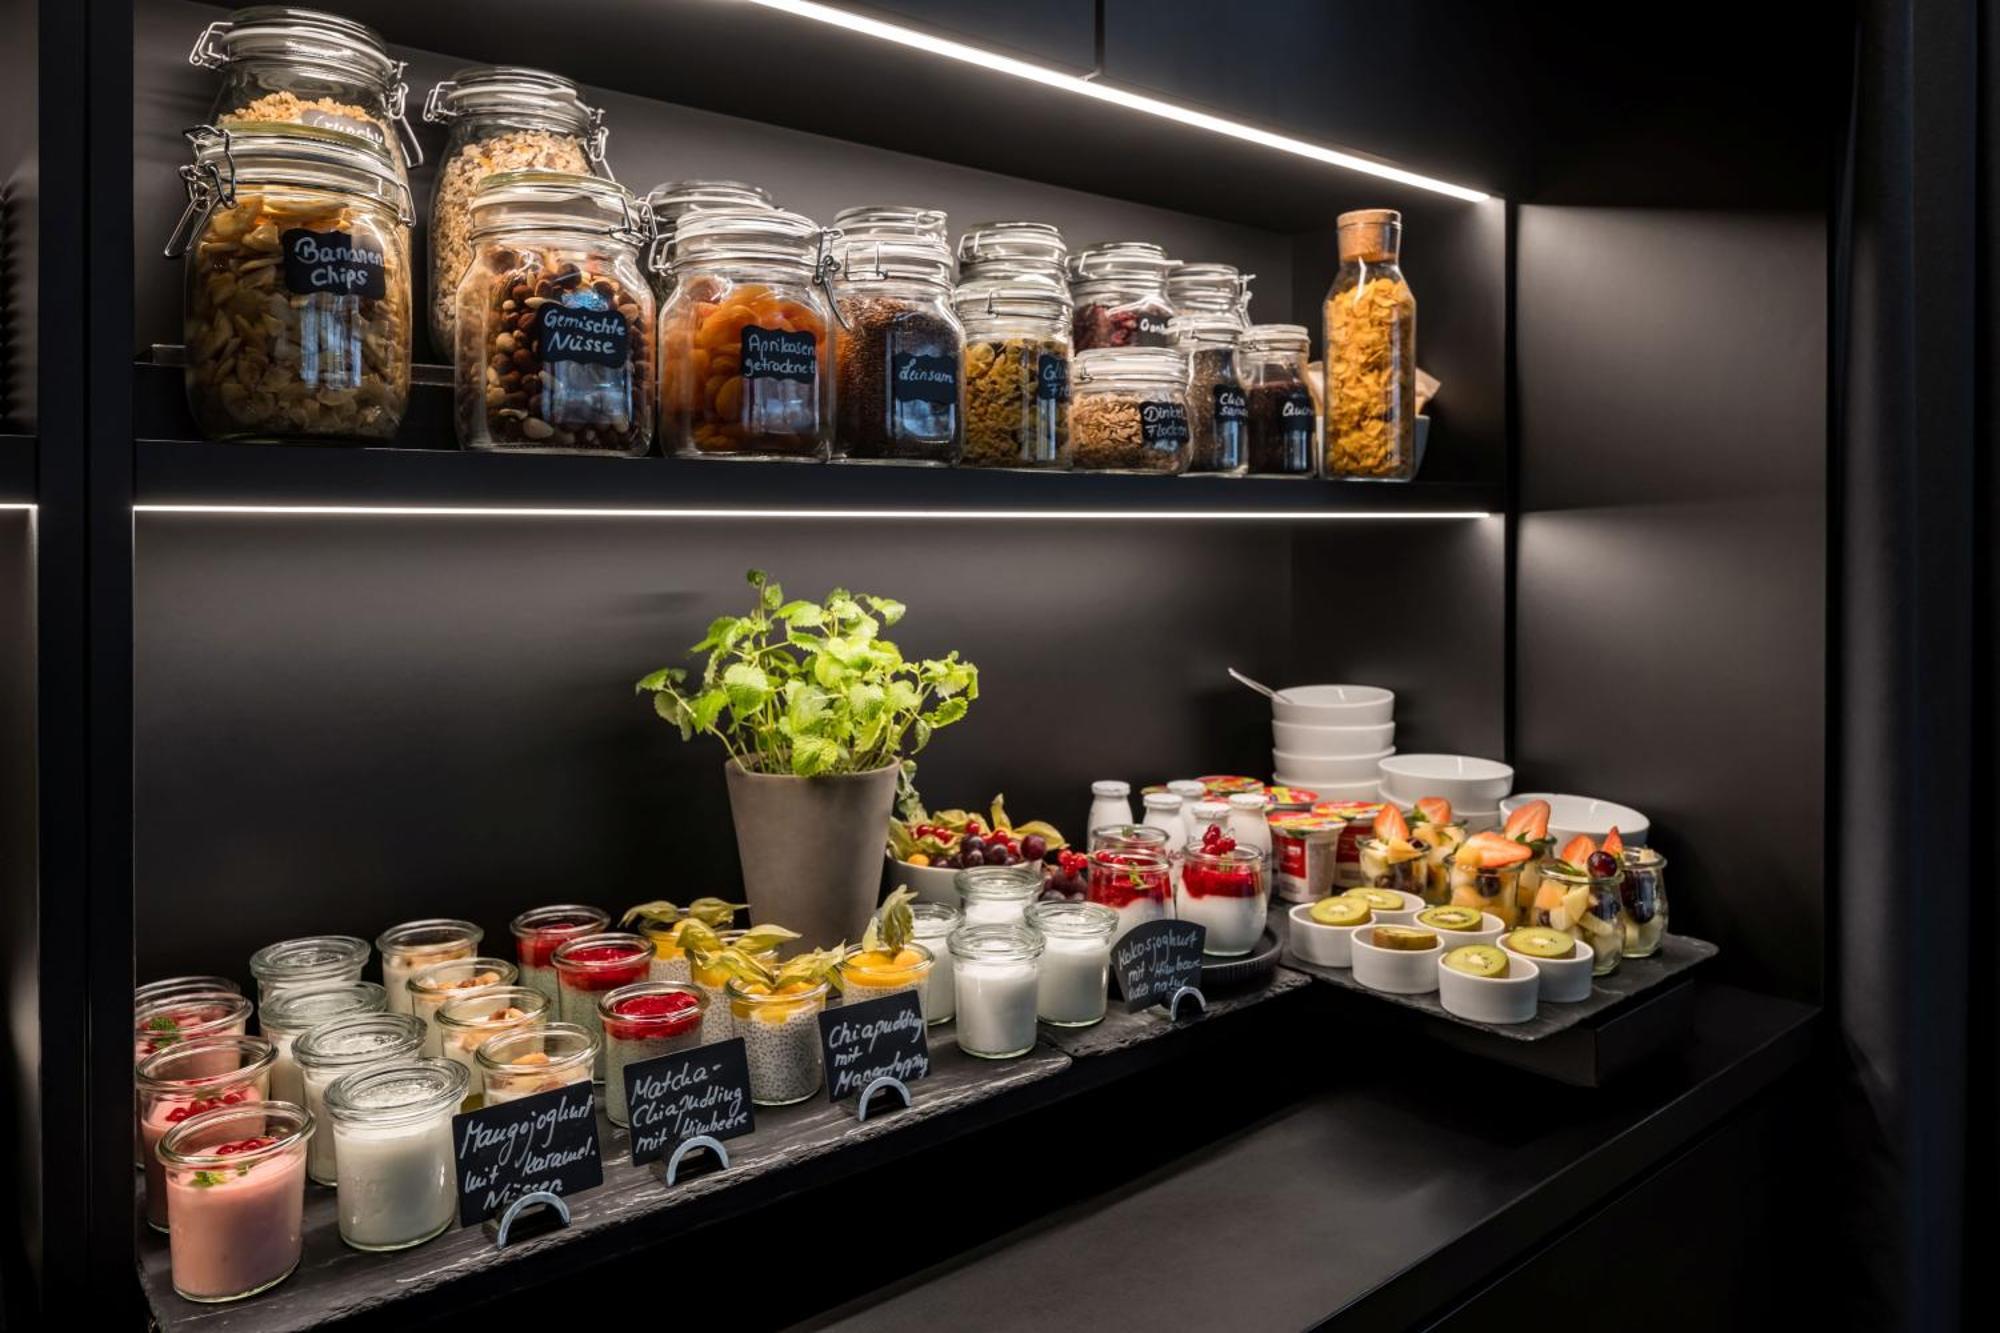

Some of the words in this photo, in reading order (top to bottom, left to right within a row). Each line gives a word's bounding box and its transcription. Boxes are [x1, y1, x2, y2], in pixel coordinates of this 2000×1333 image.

[294, 236, 385, 267] Bananen
[543, 308, 626, 337] Gemischte
[547, 331, 616, 354] Nüsse
[1127, 960, 1146, 986] mit
[828, 1009, 923, 1054] Chiapudding
[834, 1046, 863, 1067] mit
[630, 1062, 722, 1106] Matcha-
[632, 1085, 743, 1134] Chiapudding
[459, 1094, 594, 1168] Mangojoghurt
[635, 1127, 668, 1154] mit
[464, 1165, 500, 1193] mit
